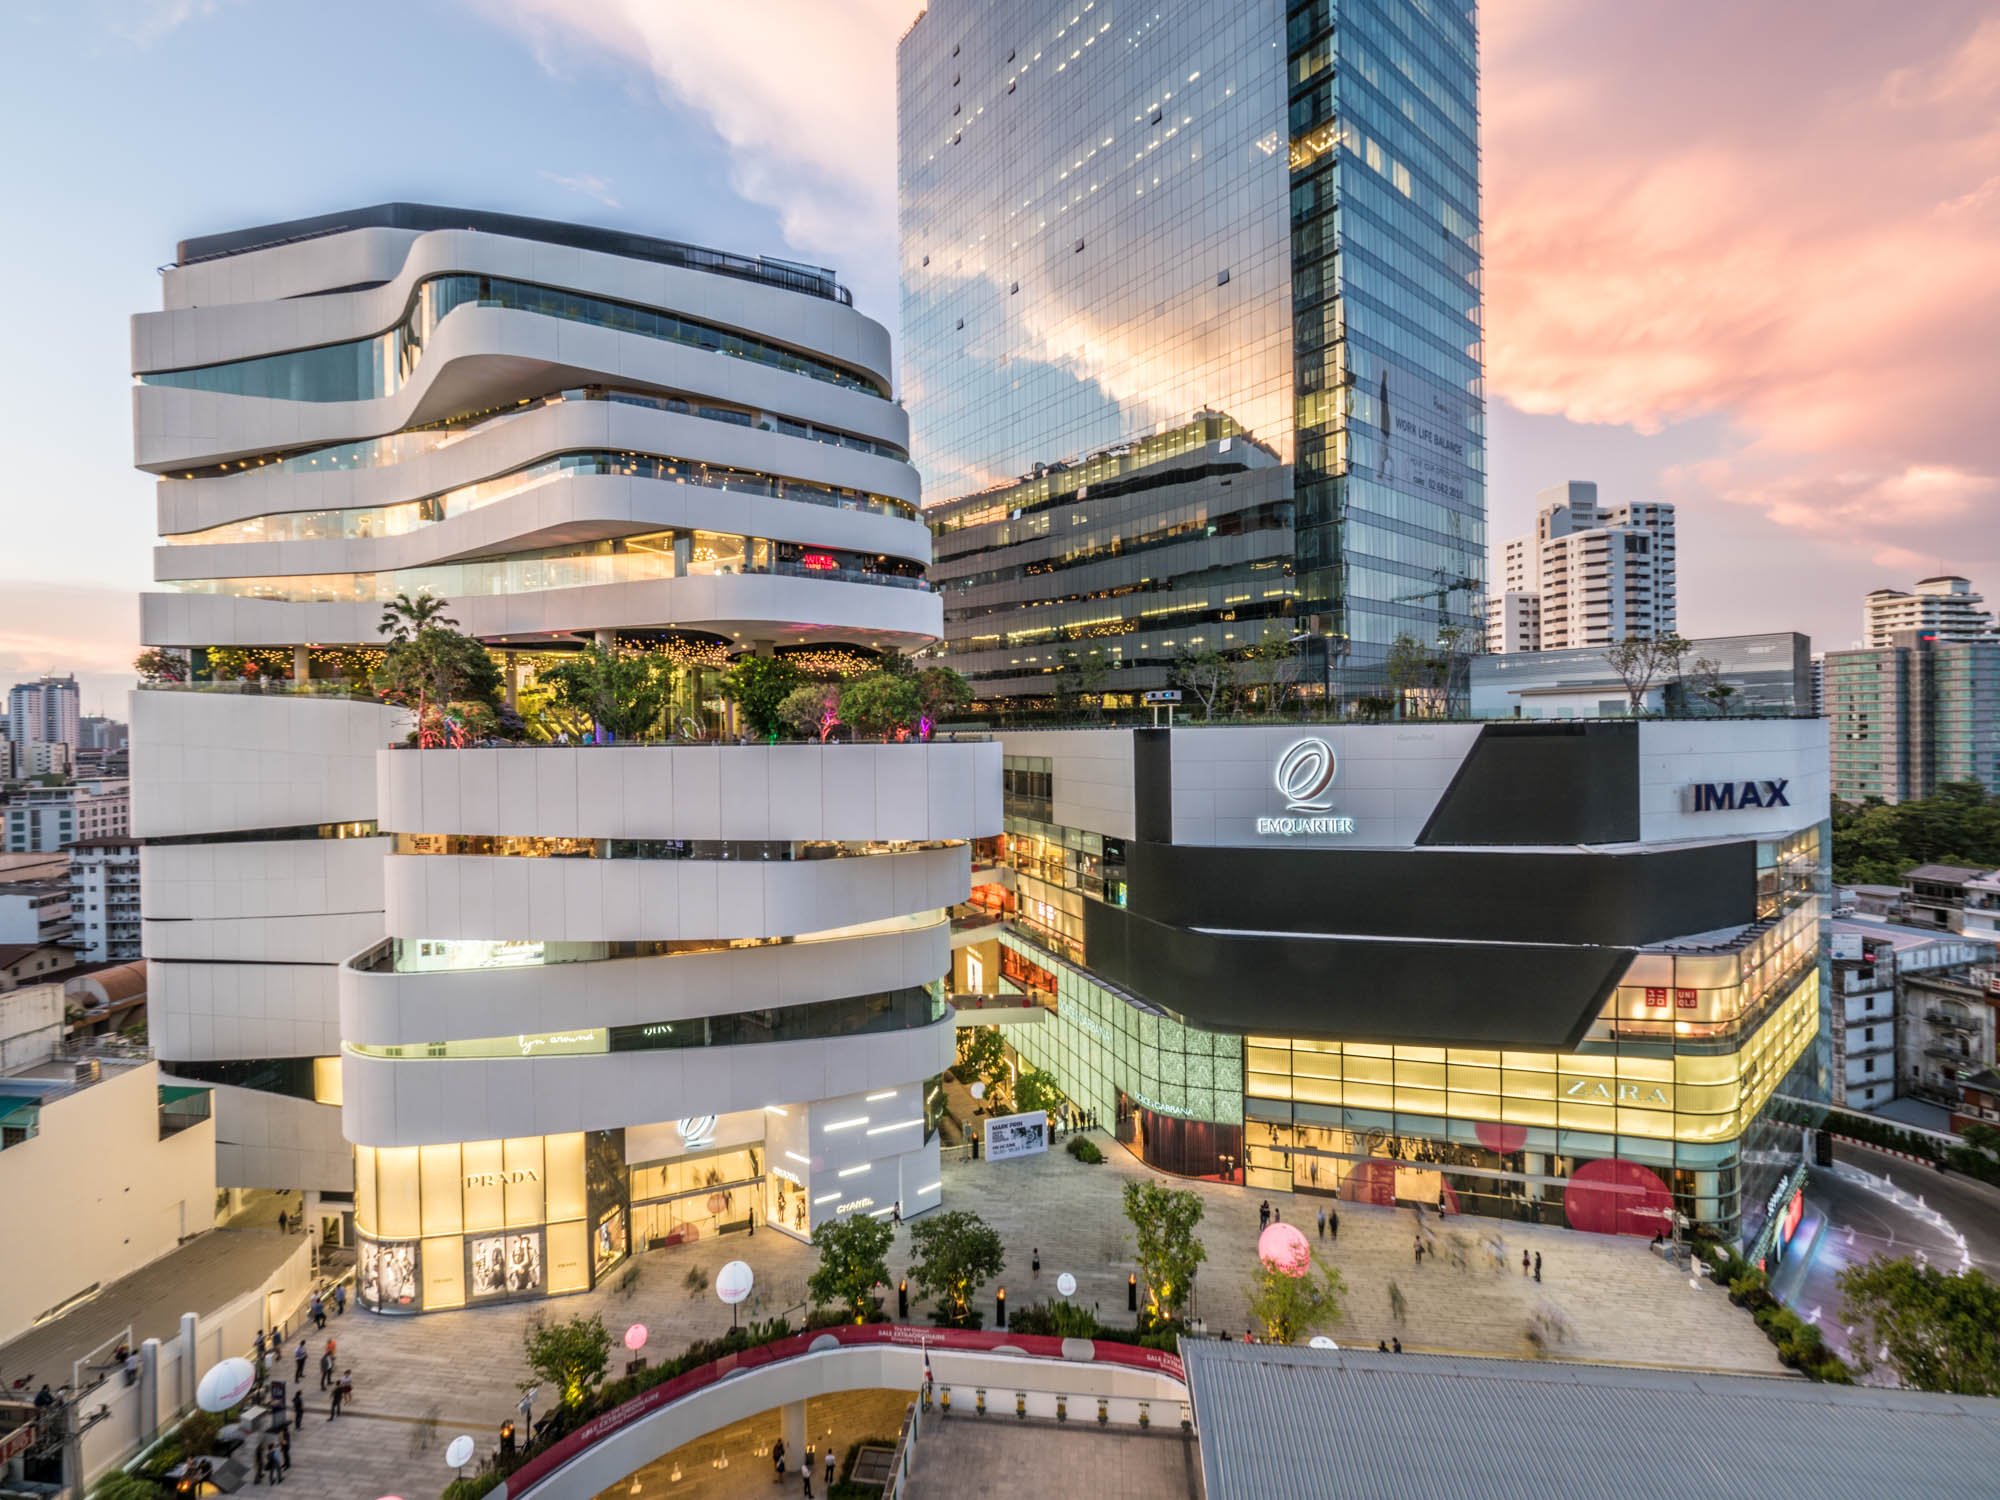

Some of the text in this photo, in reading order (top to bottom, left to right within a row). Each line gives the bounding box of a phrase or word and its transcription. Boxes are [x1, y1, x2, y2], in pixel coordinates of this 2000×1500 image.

[1395, 416, 1463, 457] WORK LIFE BALANCE
[804, 554, 833, 564] WINE
[1687, 780, 1791, 812] IMAX
[1257, 817, 1354, 836] EMQUARTIER
[1678, 991, 1697, 999] UNI
[518, 1032, 595, 1056] lyn around
[1566, 1080, 1669, 1105] ZARA
[992, 1123, 1009, 1131] MARK
[466, 1171, 539, 1189] PRADA
[772, 1166, 801, 1185] CHANEL
[836, 1198, 874, 1214] CHANEL
[1146, 1354, 1161, 1362] SALE
